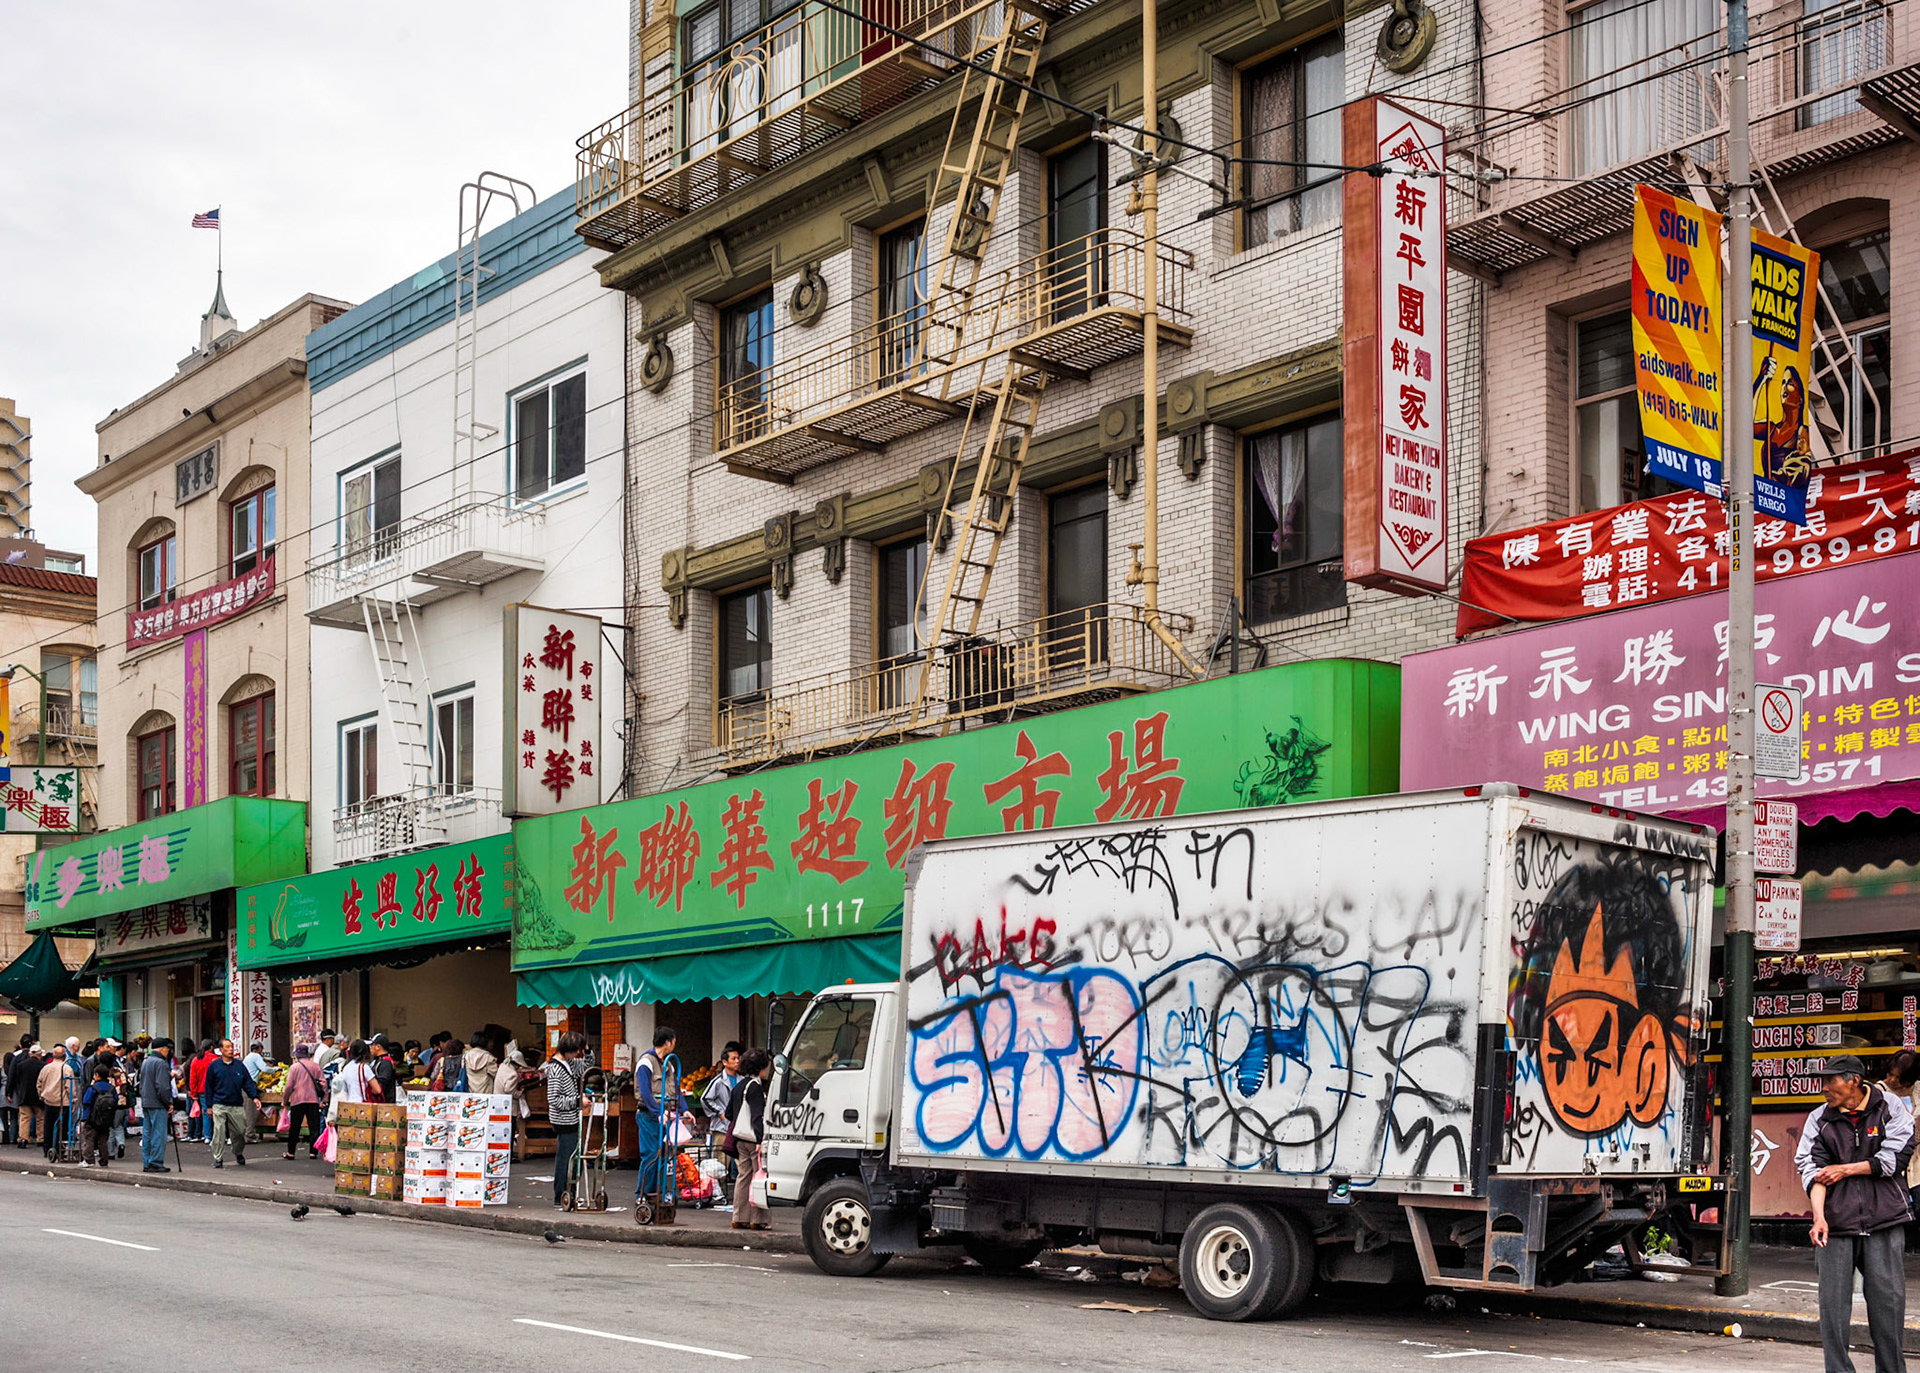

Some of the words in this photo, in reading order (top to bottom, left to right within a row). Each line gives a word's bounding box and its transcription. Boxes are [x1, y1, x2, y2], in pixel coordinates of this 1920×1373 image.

[1659, 209, 1698, 248] SIGN
[1666, 254, 1689, 284] UP
[1751, 253, 1799, 296] AIDS
[1646, 289, 1709, 333] TODAY!
[1751, 286, 1797, 326] WALK
[1761, 318, 1796, 340] FRANCISCO
[1639, 351, 1718, 392] aidswalk.net
[1642, 389, 1667, 420] (415)
[1669, 399, 1718, 432] 615-WALK
[1385, 433, 1401, 458] NEW
[1403, 439, 1419, 463] PING
[1421, 444, 1440, 469] YUEN
[1656, 445, 1687, 473] JULY
[1694, 456, 1712, 480] 18
[1394, 462, 1424, 491] BAKERY
[1755, 480, 1785, 500] WELLS
[1388, 487, 1436, 520] RESTAURANT
[1757, 494, 1786, 515] FARGO
[1517, 704, 1631, 745] WING
[1652, 685, 1730, 724] SIN
[1783, 661, 1873, 700] DIM
[1599, 785, 1679, 808] TEL.
[1754, 803, 1765, 822] NO
[1770, 804, 1792, 815] DOUBLE
[1770, 816, 1792, 827] PARKING
[1754, 837, 1794, 849] COMMERCIAL
[1757, 828, 1772, 837] ANY
[1775, 829, 1790, 838] TIME
[1757, 847, 1790, 858] VEHICLES
[1757, 880, 1770, 899] NO
[1772, 886, 1800, 900] PARKING
[806, 899, 864, 928] 1117
[1758, 905, 1765, 918] 2
[1782, 907, 1788, 919] 6
[1753, 1026, 1792, 1047] UNCH
[1762, 1079, 1788, 1095] DIM
[1790, 1077, 1823, 1094] SUM
